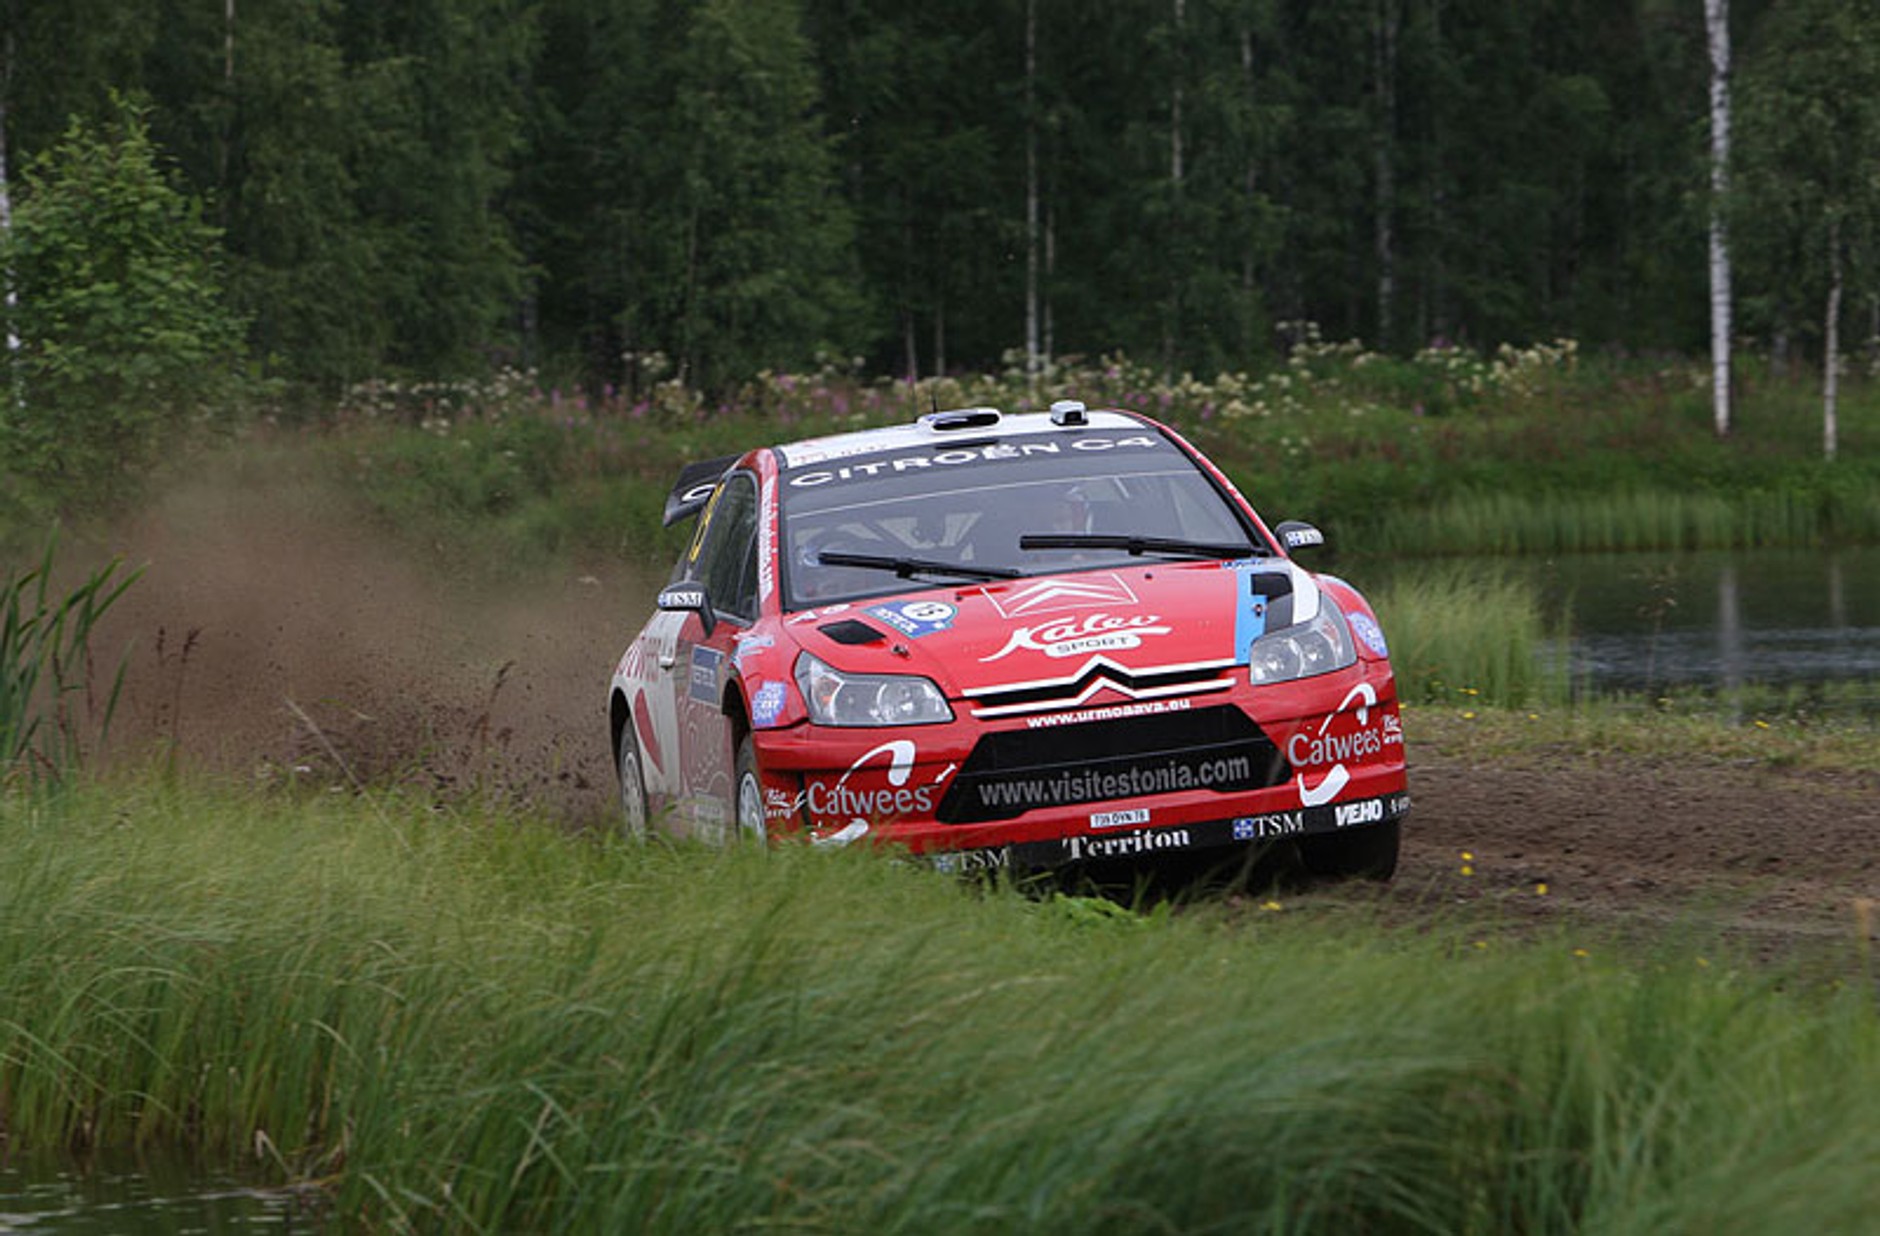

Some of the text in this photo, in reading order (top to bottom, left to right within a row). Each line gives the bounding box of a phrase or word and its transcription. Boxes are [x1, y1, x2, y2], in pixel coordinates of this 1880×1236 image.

[790, 438, 1061, 487] CITROËN
[1072, 437, 1157, 451] C4
[978, 612, 1172, 662] Kalev
[1056, 636, 1130, 654] SPORT
[1027, 699, 1191, 729] www.urmoaava.eu
[1288, 727, 1380, 767] Catwees
[979, 755, 1250, 806] www.visitestonia.com
[807, 781, 933, 816] Catwees
[1335, 798, 1383, 827] VEHO
[1254, 812, 1305, 837] TSM
[1062, 828, 1191, 860] Territon
